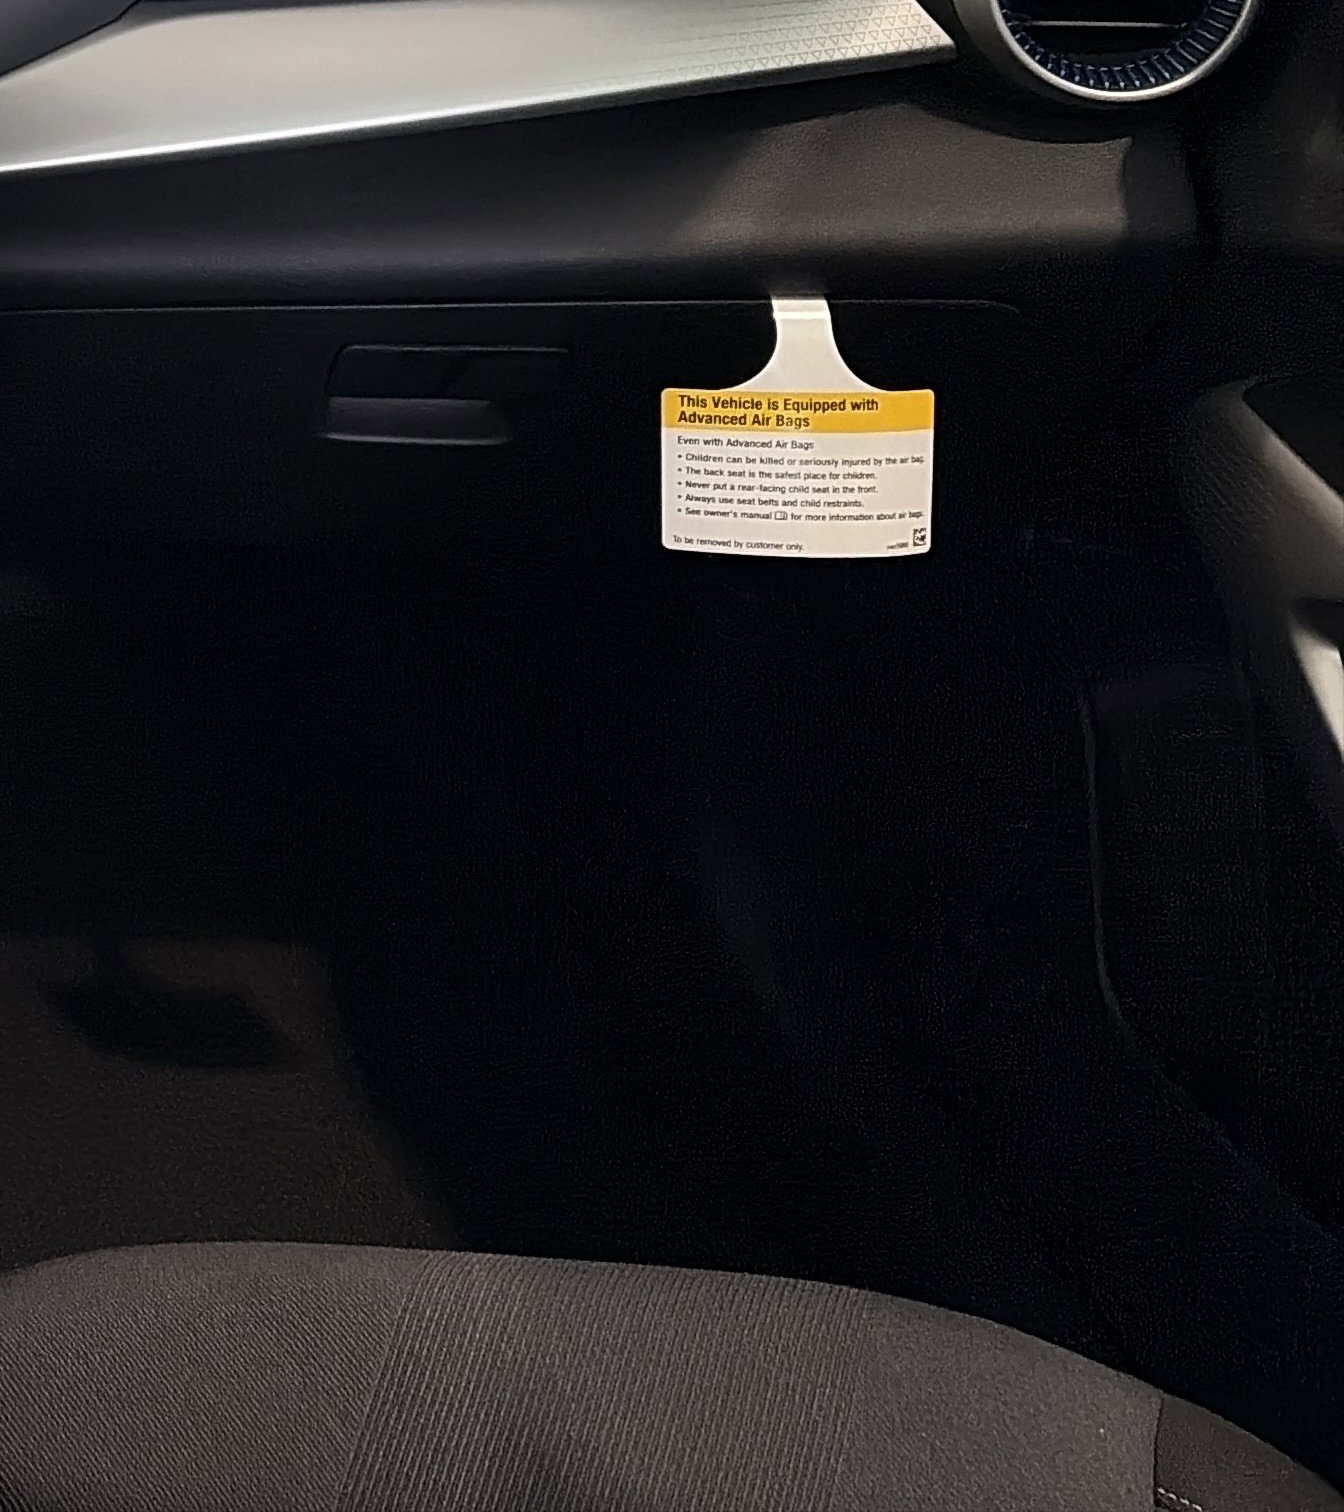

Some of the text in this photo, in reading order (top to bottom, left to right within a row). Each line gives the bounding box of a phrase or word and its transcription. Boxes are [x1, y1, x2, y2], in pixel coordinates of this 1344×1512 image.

[679, 395, 707, 408] This
[712, 396, 762, 410] Vehicle
[784, 398, 846, 413] Equipped
[851, 398, 879, 410] with
[678, 411, 810, 429] Advanced Air Bags
[677, 436, 814, 450] Even with Advanced Air Bags
[686, 453, 723, 463] Children
[726, 455, 742, 463] can
[746, 455, 756, 464] be
[759, 456, 784, 465] killed
[799, 457, 839, 467] seriously
[841, 457, 871, 467] injured
[873, 457, 883, 467] by
[686, 467, 701, 475] The
[704, 467, 724, 476] back
[727, 469, 746, 477] seat
[749, 470, 756, 478] is
[758, 470, 772, 478] the
[775, 471, 801, 479] safest
[804, 471, 826, 481] place
[843, 472, 877, 480] children.
[686, 481, 710, 489] Never
[713, 483, 727, 492] put
[737, 484, 786, 494] rear-facing
[788, 485, 809, 493] child
[685, 494, 715, 504] Always
[758, 498, 779, 506] belts
[782, 499, 797, 507] and
[800, 499, 821, 507] child
[685, 507, 701, 515] See
[704, 509, 737, 518] owner's
[741, 512, 772, 520] manual
[672, 535, 682, 543] To
[684, 536, 694, 544] be
[697, 538, 732, 548] removed
[734, 540, 744, 549] by
[746, 541, 784, 549] customer
